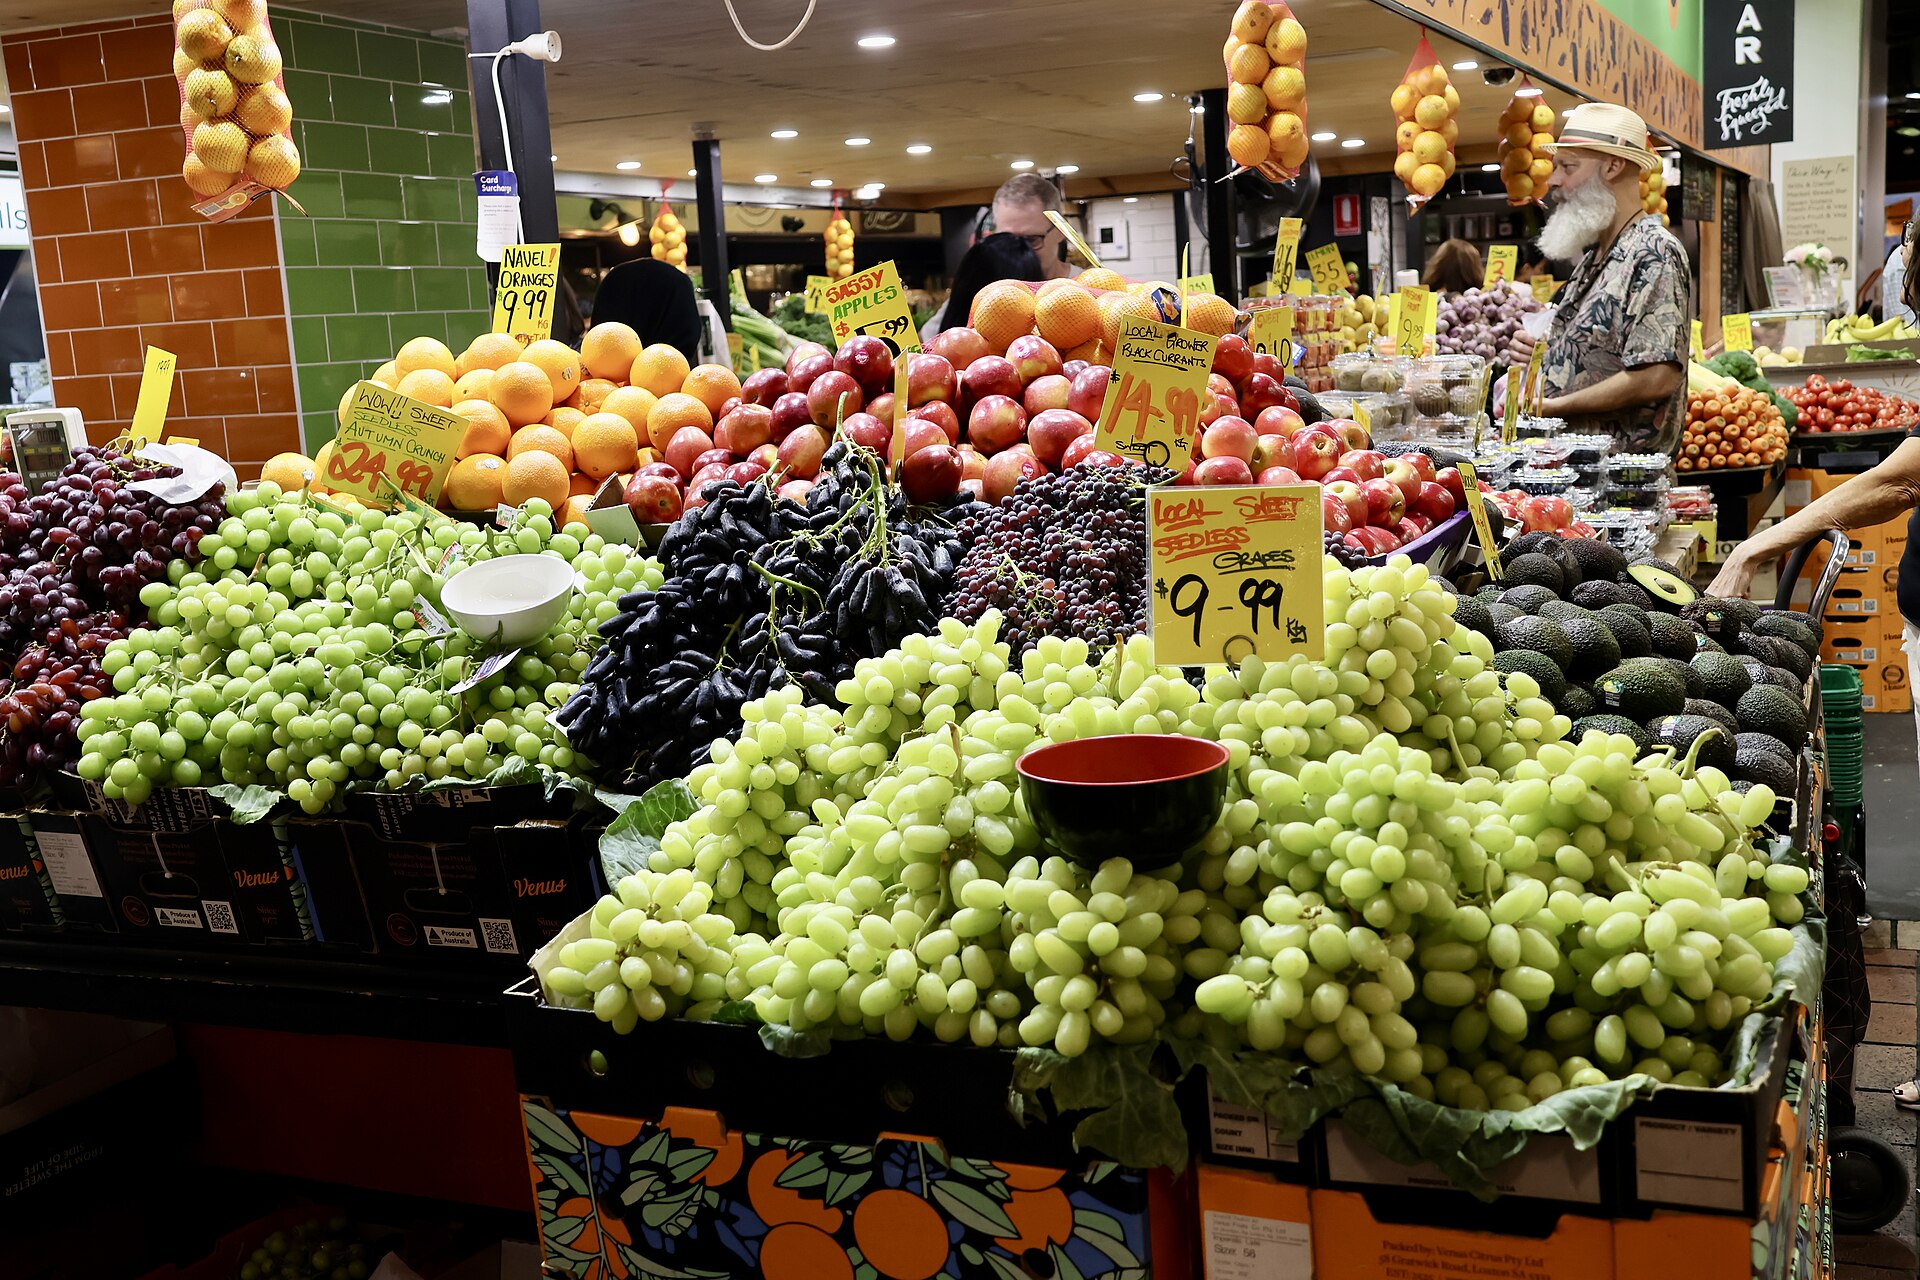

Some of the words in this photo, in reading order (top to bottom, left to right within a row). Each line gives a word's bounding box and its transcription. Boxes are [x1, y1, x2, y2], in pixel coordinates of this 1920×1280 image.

[1735, 3, 1763, 65] AR
[1715, 75, 1775, 122] Freshly
[1720, 87, 1789, 141] Squeezed
[480, 176, 499, 184] Card
[1811, 165, 1832, 180] Way
[0, 201, 28, 229] ils
[500, 270, 555, 288] ORANGES
[825, 269, 884, 304] SASSY
[833, 285, 898, 322] APPLES
[1125, 321, 1163, 339] LOCAL
[1121, 342, 1151, 359] BLACK
[1153, 349, 1207, 369] CURRANTS
[353, 411, 422, 437] SEEDLESS
[410, 407, 457, 430] SWEET
[344, 420, 404, 450] AUTUMN
[405, 438, 446, 464] CRUNCH
[1154, 498, 1224, 527] LOCAL
[1233, 491, 1305, 520] SWEET
[1153, 526, 1251, 557] SEEDLESS
[1213, 549, 1296, 571] GRAPES
[107, 802, 118, 822] ONE
[0, 865, 30, 881] enus
[234, 869, 280, 888] Venus
[513, 877, 568, 899] Venus
[169, 911, 190, 920] Produce
[172, 917, 197, 926] Australia
[441, 929, 464, 938] Produce
[443, 938, 470, 946] Australia
[1214, 1127, 1242, 1137] COUNT
[1639, 1121, 1686, 1131] PRODUCT
[48, 1153, 61, 1167] OF
[63, 1142, 86, 1160] SIDE
[23, 1159, 45, 1177] LIFE
[53, 1159, 73, 1175] THE
[5, 1168, 52, 1197] SWEETER
[1382, 1240, 1418, 1253] Packed
[1436, 1246, 1468, 1259] Venus
[1469, 1250, 1503, 1262] Citrus
[1504, 1254, 1522, 1267] Pty
[1525, 1256, 1545, 1268] Ltd
[1441, 1260, 1470, 1273] Road,
[1472, 1263, 1510, 1277] Loxton
[1511, 1270, 1526, 1280] SA
